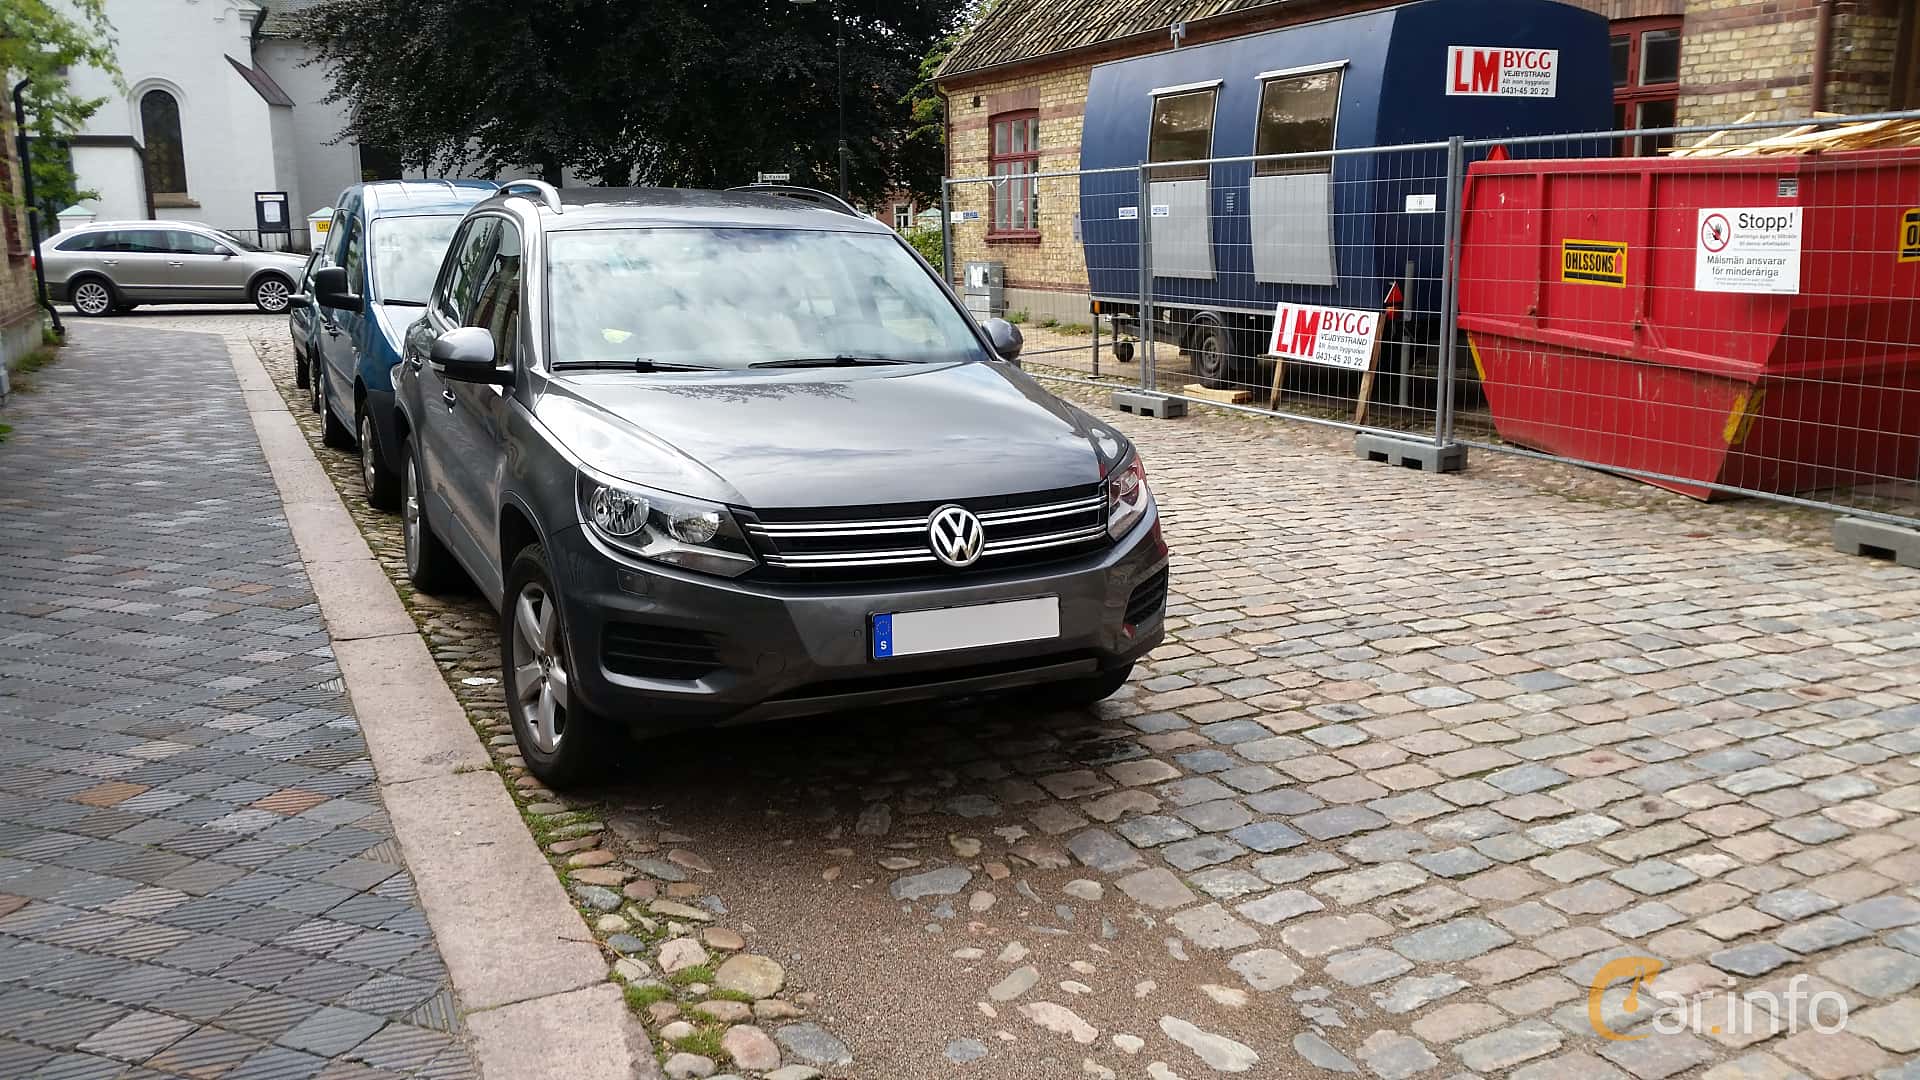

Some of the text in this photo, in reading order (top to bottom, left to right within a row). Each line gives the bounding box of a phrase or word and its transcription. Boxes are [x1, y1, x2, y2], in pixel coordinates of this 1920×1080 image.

[1454, 50, 1551, 92] LM BYGG
[1503, 70, 1551, 78] VEJBYSTRAND
[1501, 86, 1528, 95] 0431-45
[1530, 87, 1539, 95] 20
[1738, 212, 1793, 232] Stopp!
[1565, 251, 1614, 273] OHLSSONS
[1707, 255, 1787, 266] Målsmän ansvarar
[1712, 266, 1779, 278] för minderåriga
[1276, 308, 1370, 357] LM BYGG
[1321, 333, 1368, 346] VEJBYSTRAND
[1315, 351, 1363, 366] 0431-45 20 22
[929, 505, 984, 566] VW
[880, 640, 887, 650] S
